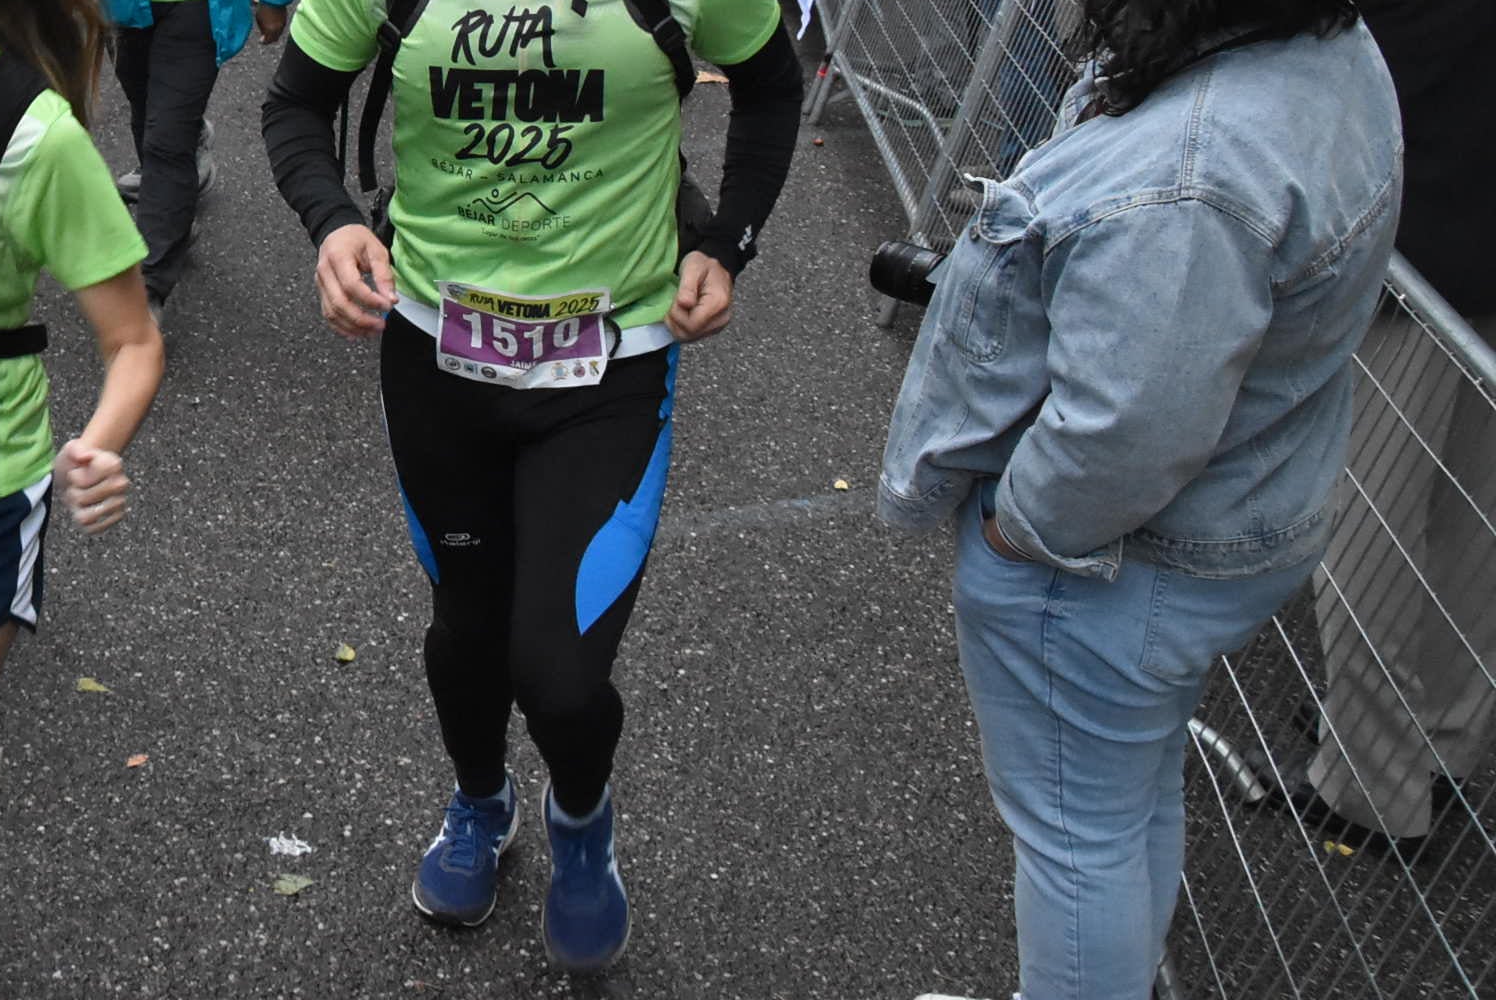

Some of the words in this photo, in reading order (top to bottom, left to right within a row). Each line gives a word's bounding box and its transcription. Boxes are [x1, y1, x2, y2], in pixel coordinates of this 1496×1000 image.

[450, 4, 557, 68] RUTA
[428, 65, 605, 123] VETONA
[455, 122, 575, 170] 2025
[431, 157, 474, 181] BÉJAR
[497, 167, 605, 185] SALAMANCA
[457, 203, 496, 226] BÉJAR
[502, 215, 572, 232] DEPORTE
[497, 300, 551, 319] VETONA
[554, 295, 602, 317] 2025
[462, 312, 581, 360] 1510
